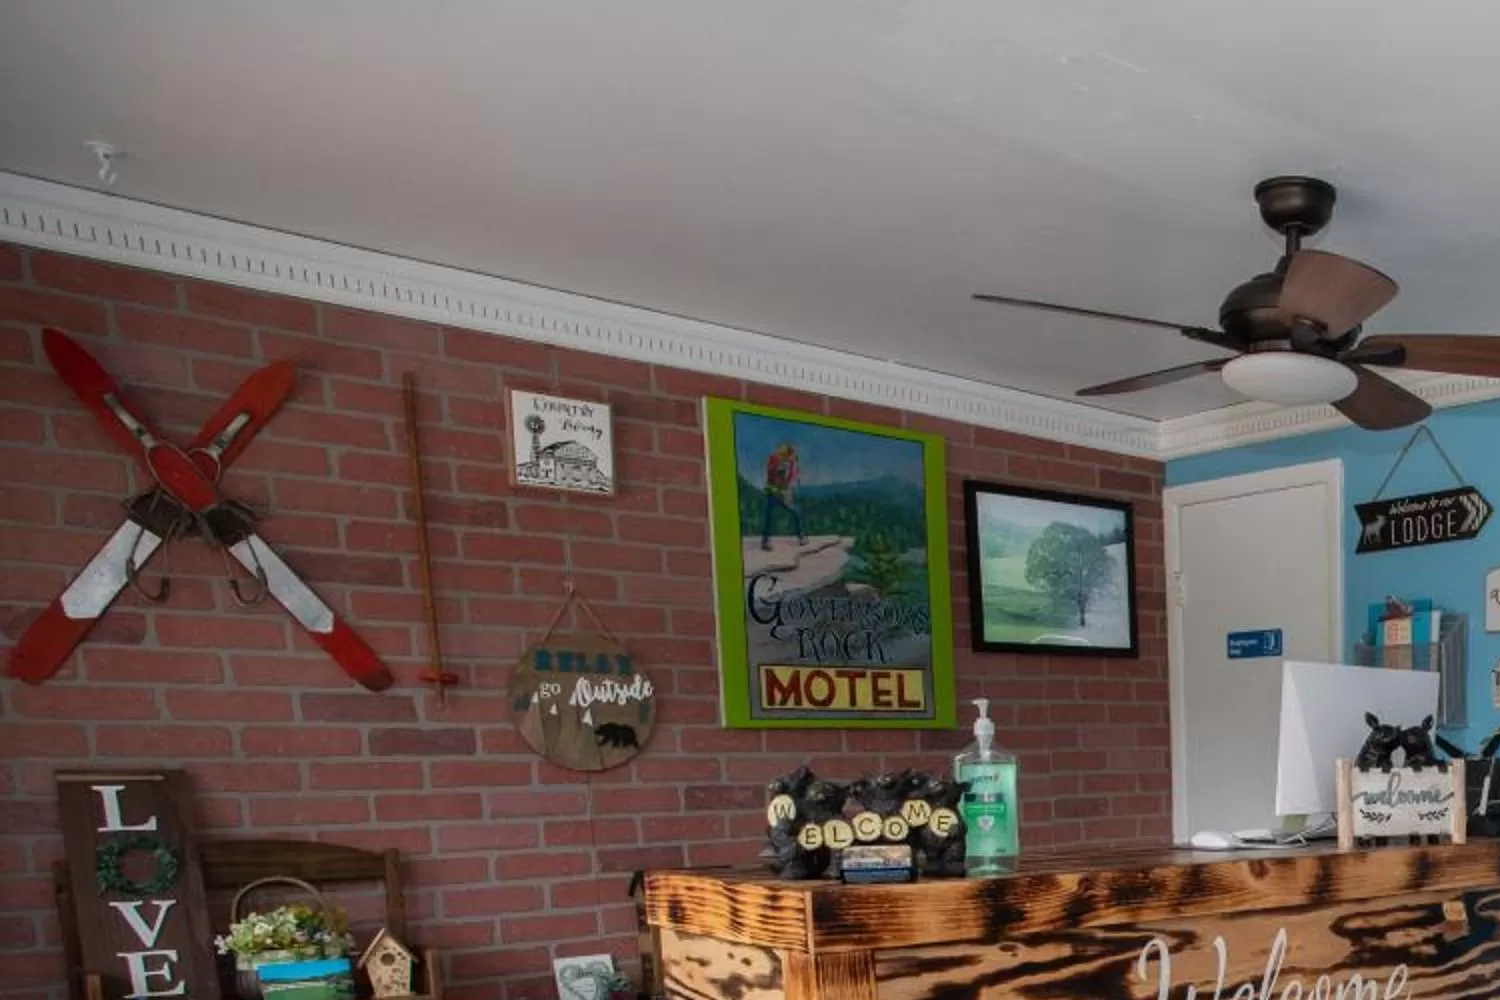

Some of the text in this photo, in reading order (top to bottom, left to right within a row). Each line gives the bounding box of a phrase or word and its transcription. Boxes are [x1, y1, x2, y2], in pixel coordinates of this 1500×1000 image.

[1391, 508, 1457, 546] LODGE
[770, 626, 894, 665] ROCK
[540, 682, 562, 698] go
[764, 667, 922, 708] MOTEL
[772, 801, 954, 846] WELCOME
